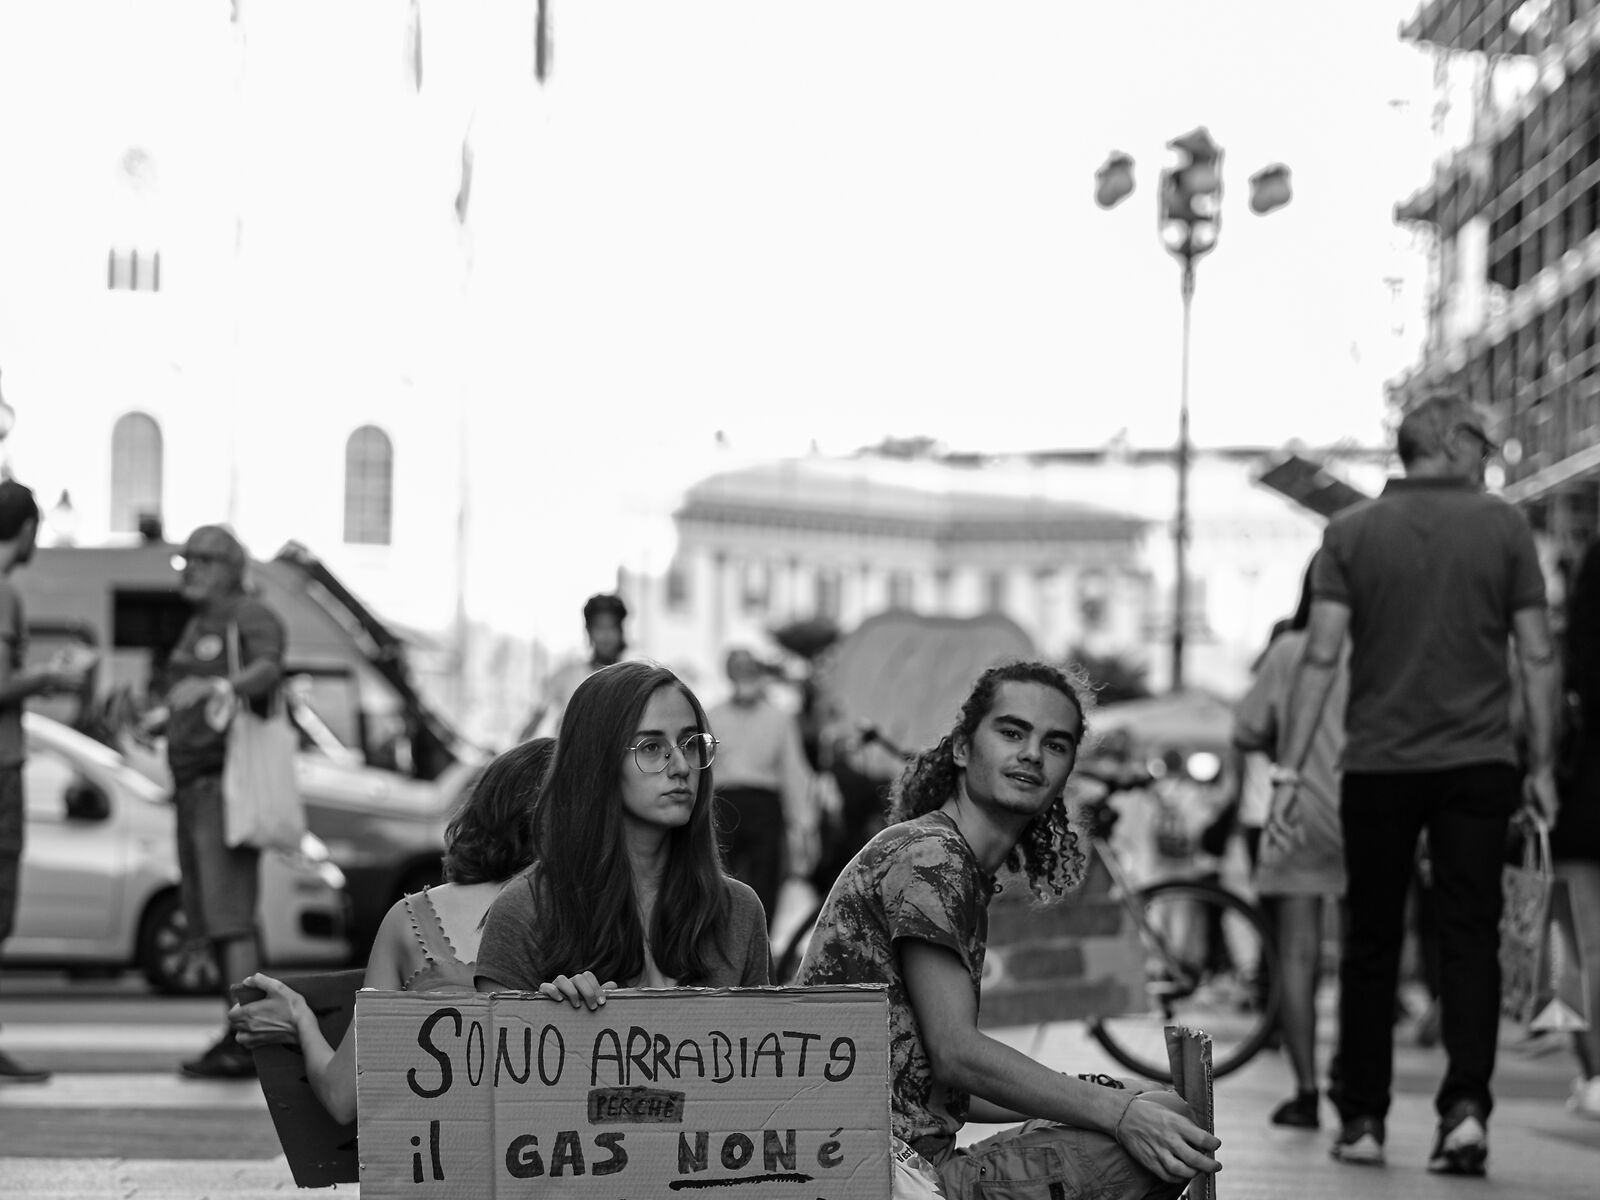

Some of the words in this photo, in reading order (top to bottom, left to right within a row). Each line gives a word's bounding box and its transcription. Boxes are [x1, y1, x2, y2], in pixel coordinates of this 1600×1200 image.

[407, 1007, 566, 1098] SONO
[411, 1120, 445, 1184] il
[506, 1130, 628, 1178] GAS
[678, 1130, 797, 1173] NON
